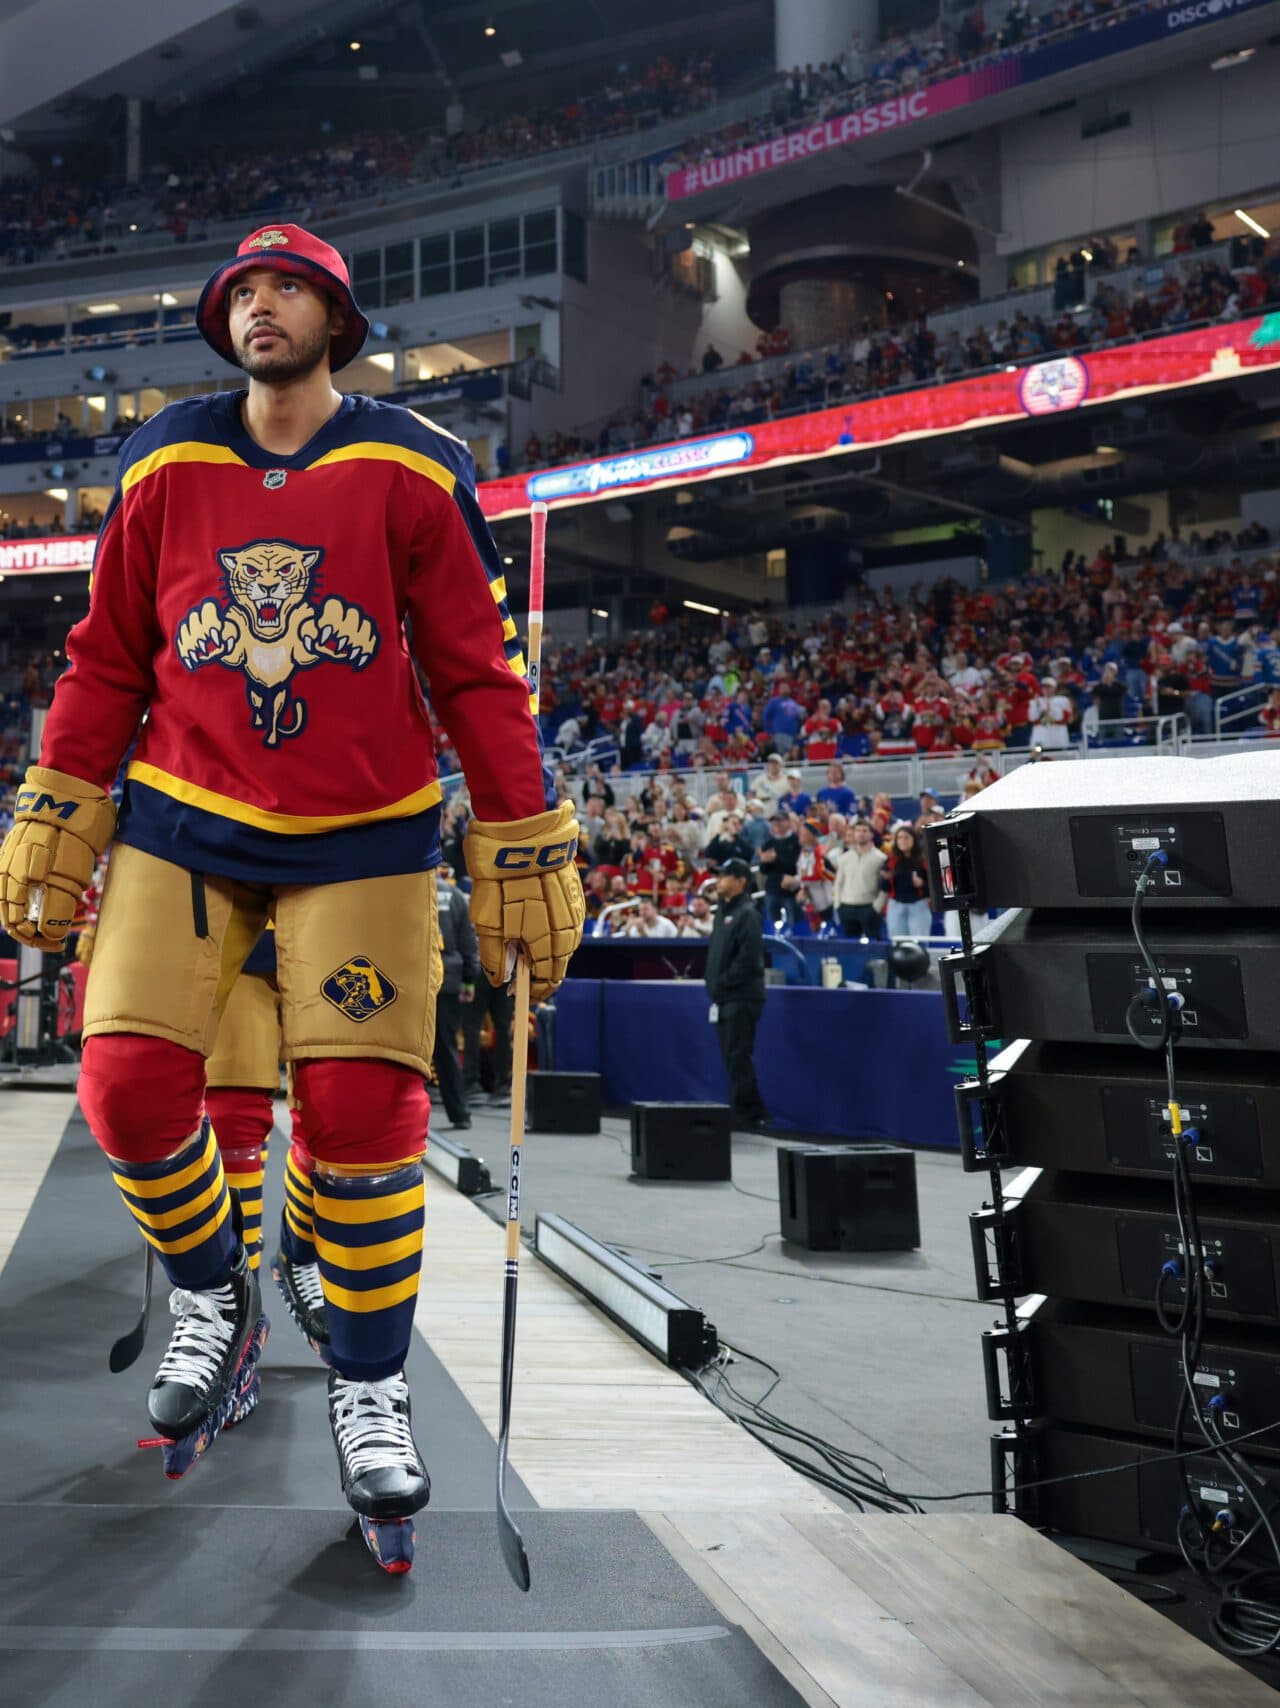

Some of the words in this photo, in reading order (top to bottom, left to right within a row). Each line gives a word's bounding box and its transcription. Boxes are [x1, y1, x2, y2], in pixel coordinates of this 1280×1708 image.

[684, 91, 928, 192] #WINTERCLASSIC
[16, 791, 80, 820] CM
[509, 1149, 520, 1221] CCM
